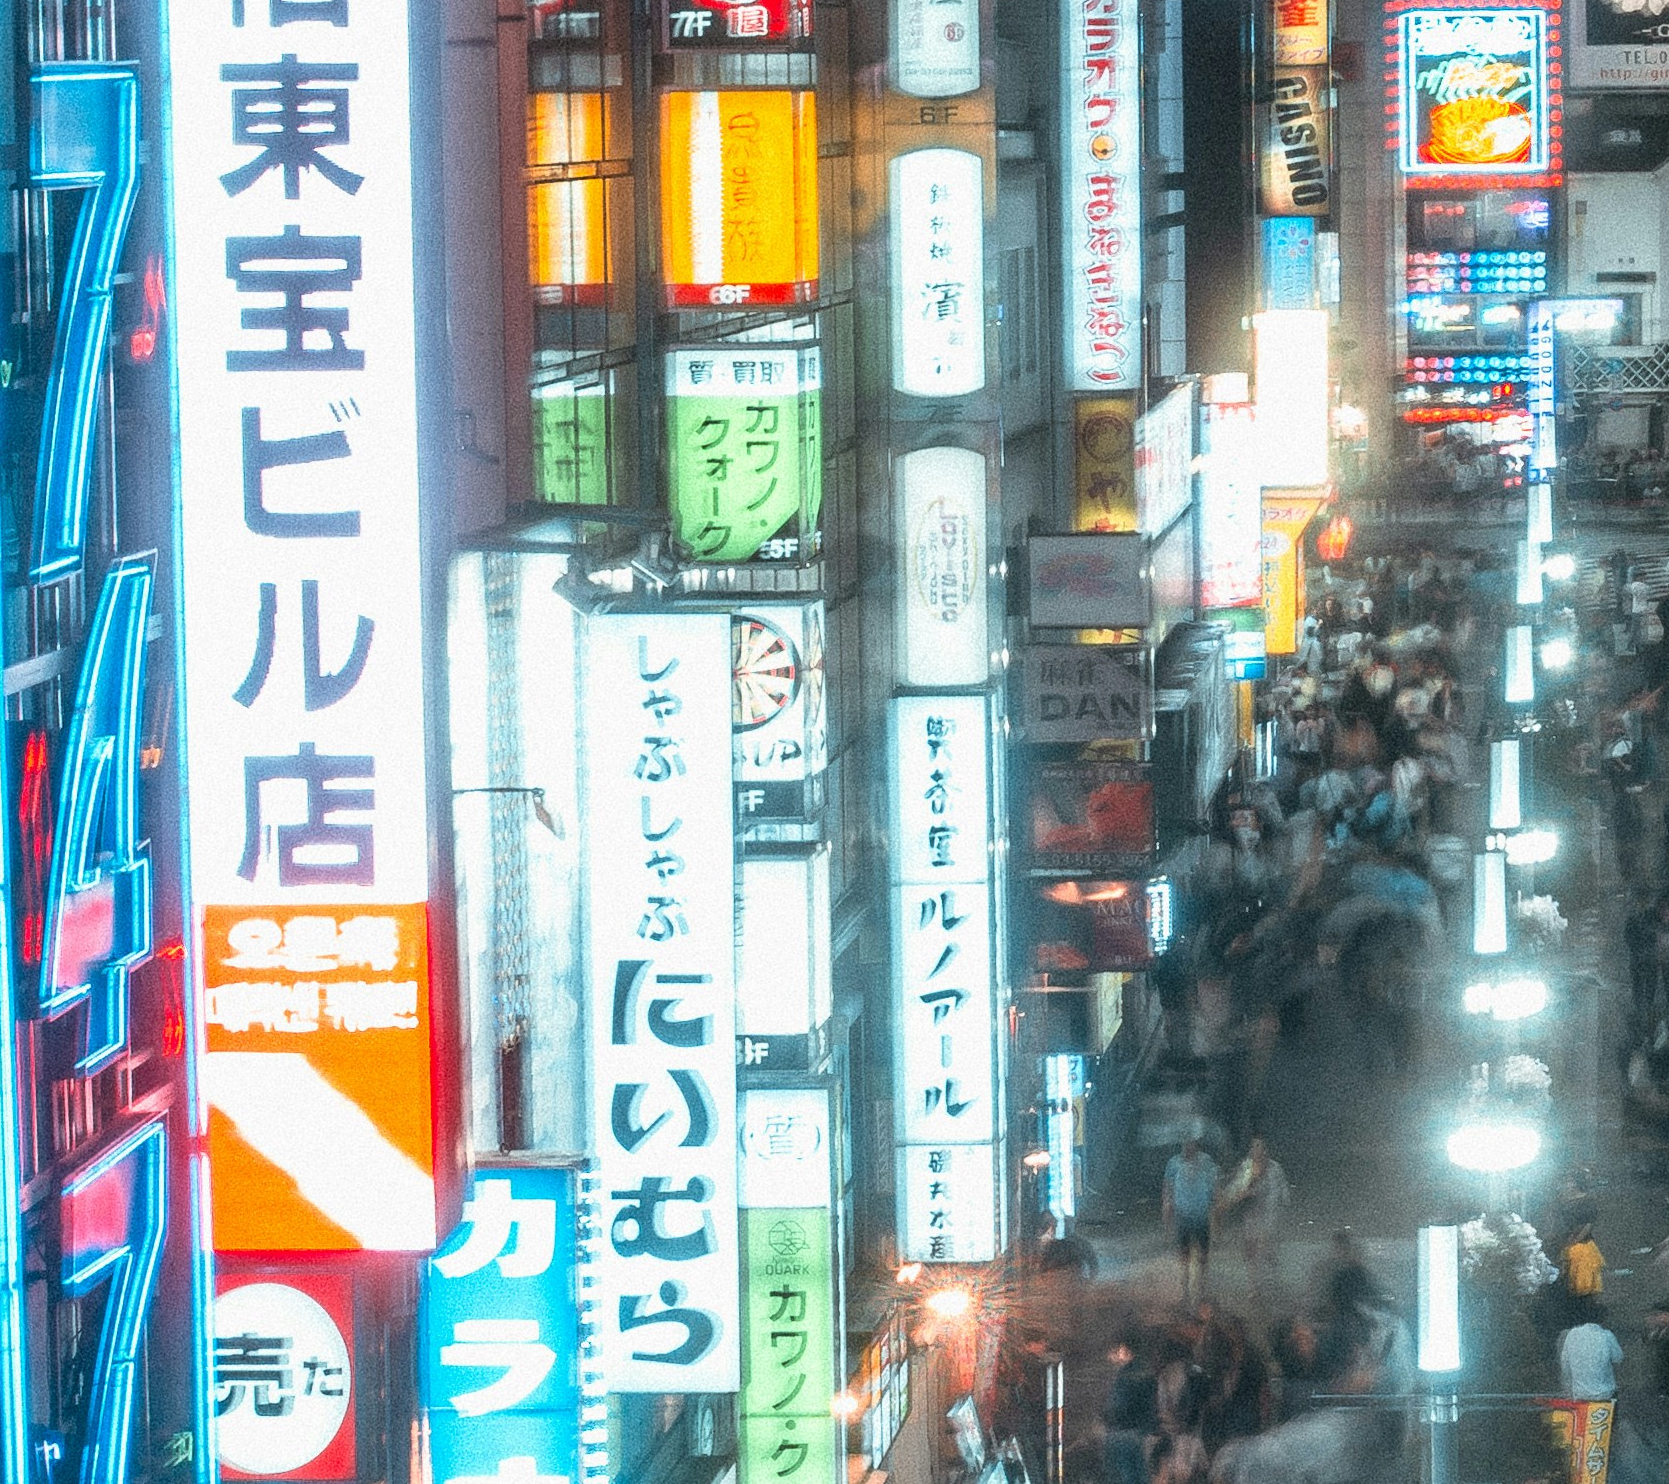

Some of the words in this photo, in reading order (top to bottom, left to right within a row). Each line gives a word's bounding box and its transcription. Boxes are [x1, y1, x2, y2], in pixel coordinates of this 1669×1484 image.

[1277, 75, 1328, 207] CASINO
[695, 415, 734, 555] クォーク
[634, 633, 688, 944] しゃぶしゃぶ
[919, 890, 979, 1120] ルノアール
[610, 958, 718, 1367] にいむら
